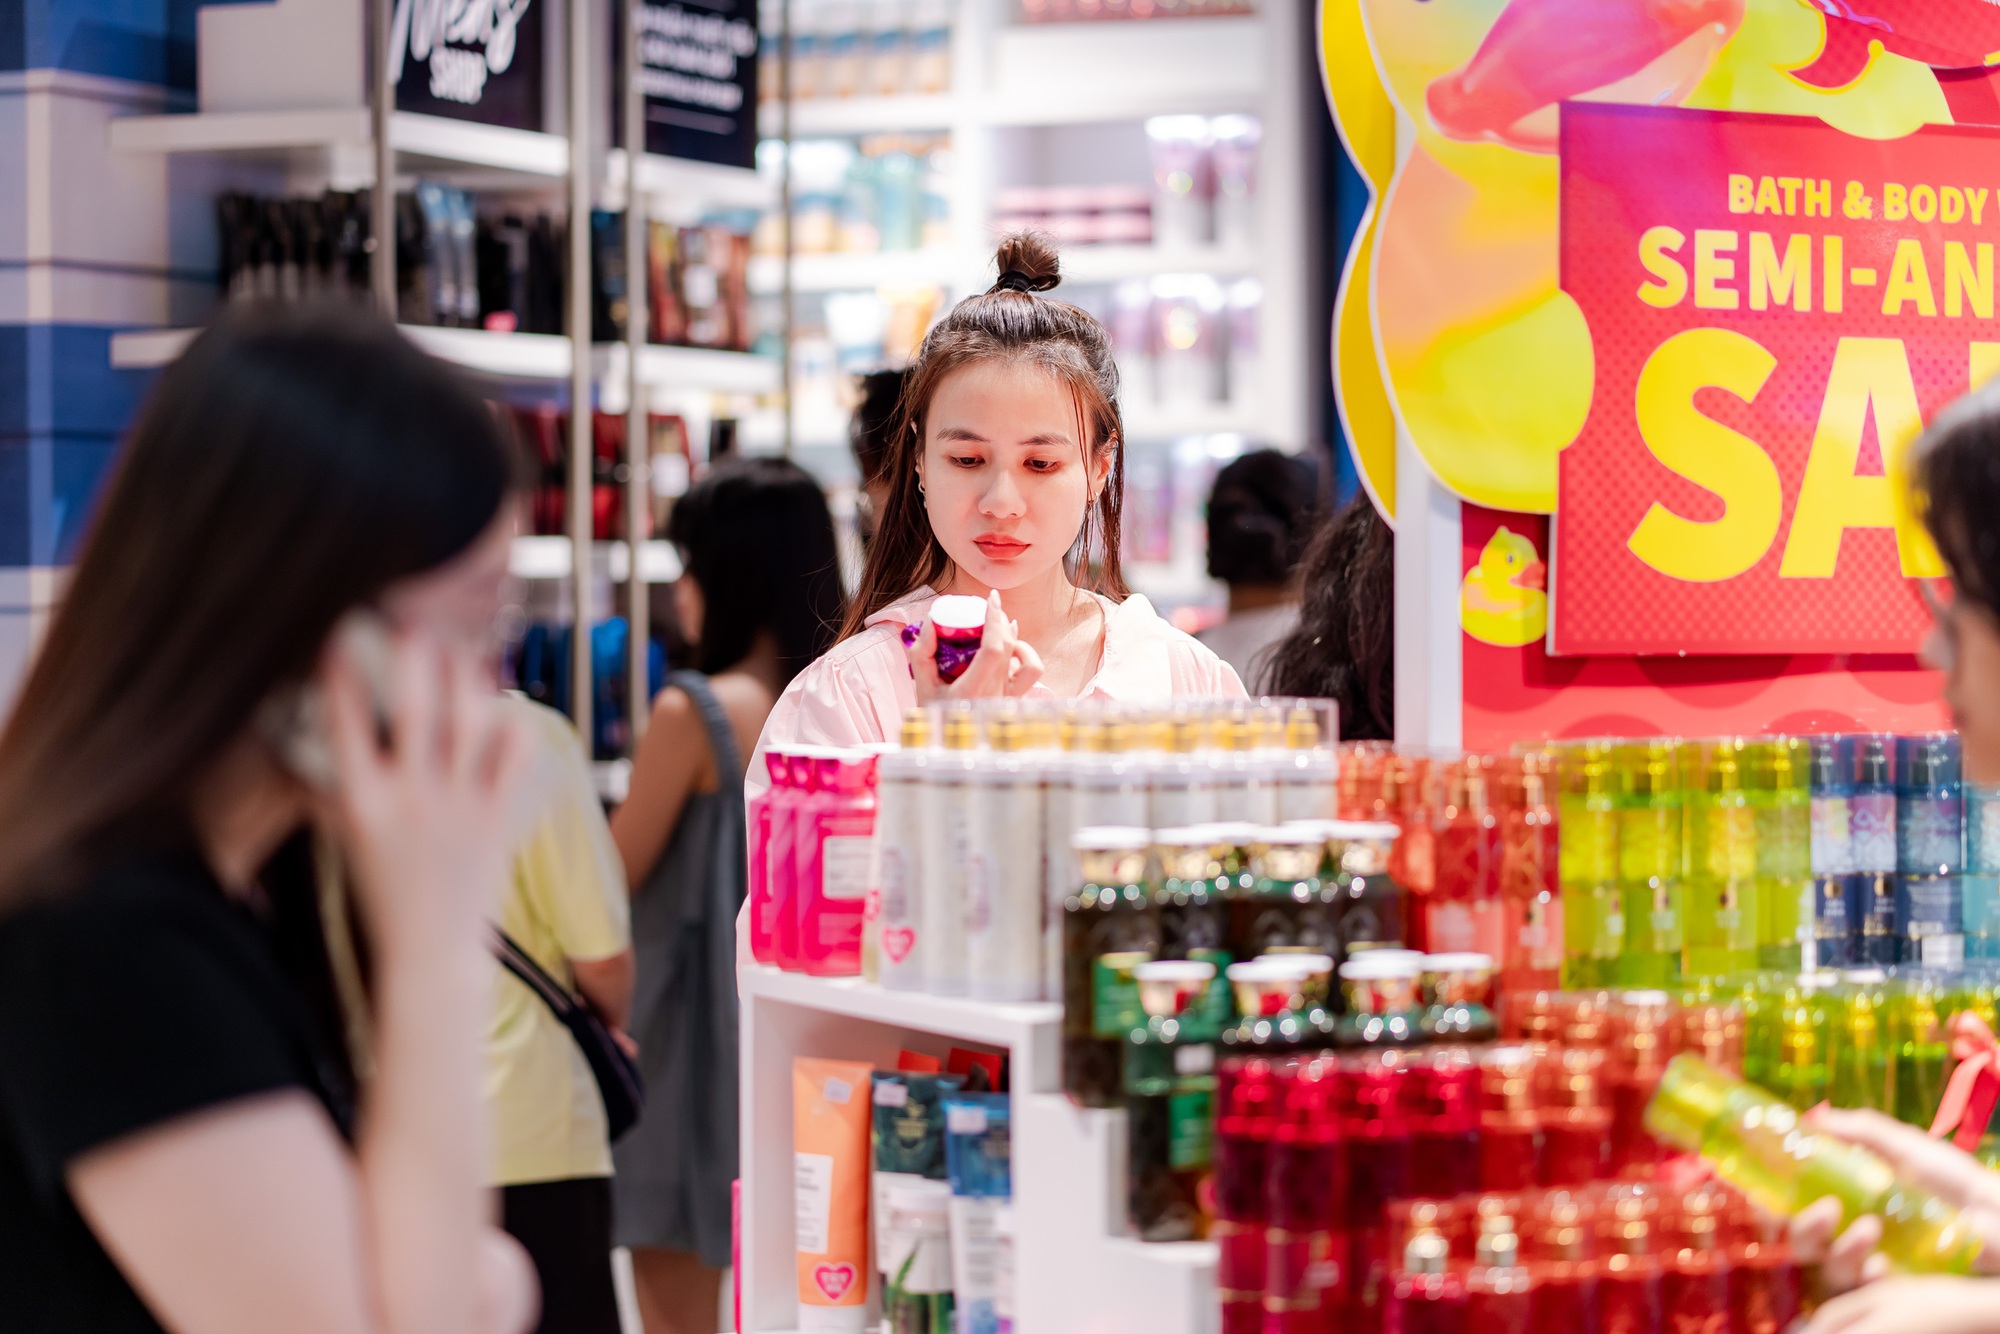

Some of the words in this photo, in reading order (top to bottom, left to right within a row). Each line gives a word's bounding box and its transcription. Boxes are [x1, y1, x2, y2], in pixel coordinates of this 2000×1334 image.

[1728, 174, 1831, 217] BATH
[1842, 180, 1872, 219] &
[1883, 183, 1989, 225] BODY
[1636, 225, 1994, 319] SEMI-AN
[1626, 326, 2000, 582] SA
